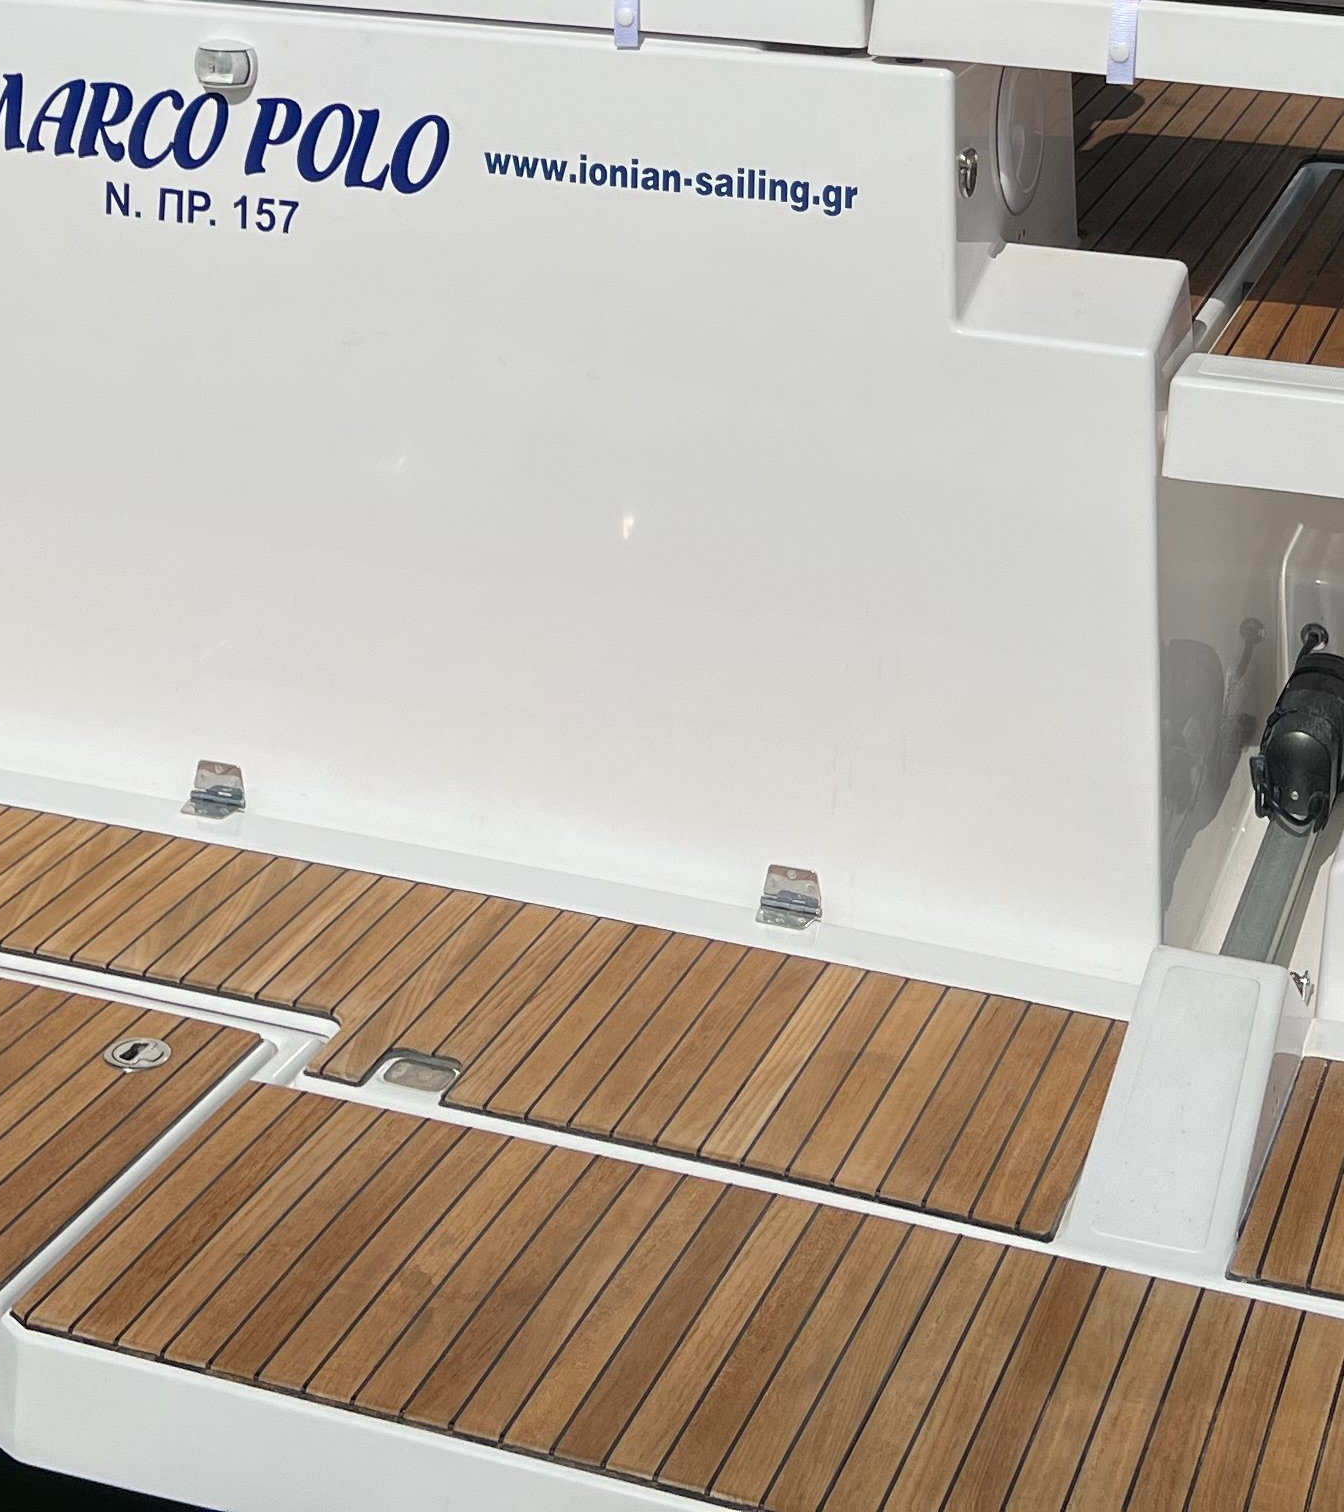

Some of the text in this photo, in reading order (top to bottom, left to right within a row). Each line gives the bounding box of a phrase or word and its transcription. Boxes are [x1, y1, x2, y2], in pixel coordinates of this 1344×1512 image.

[244, 97, 451, 195] POLO
[232, 194, 300, 234] 157
[483, 151, 859, 217] www.ionian-sailing.gr
